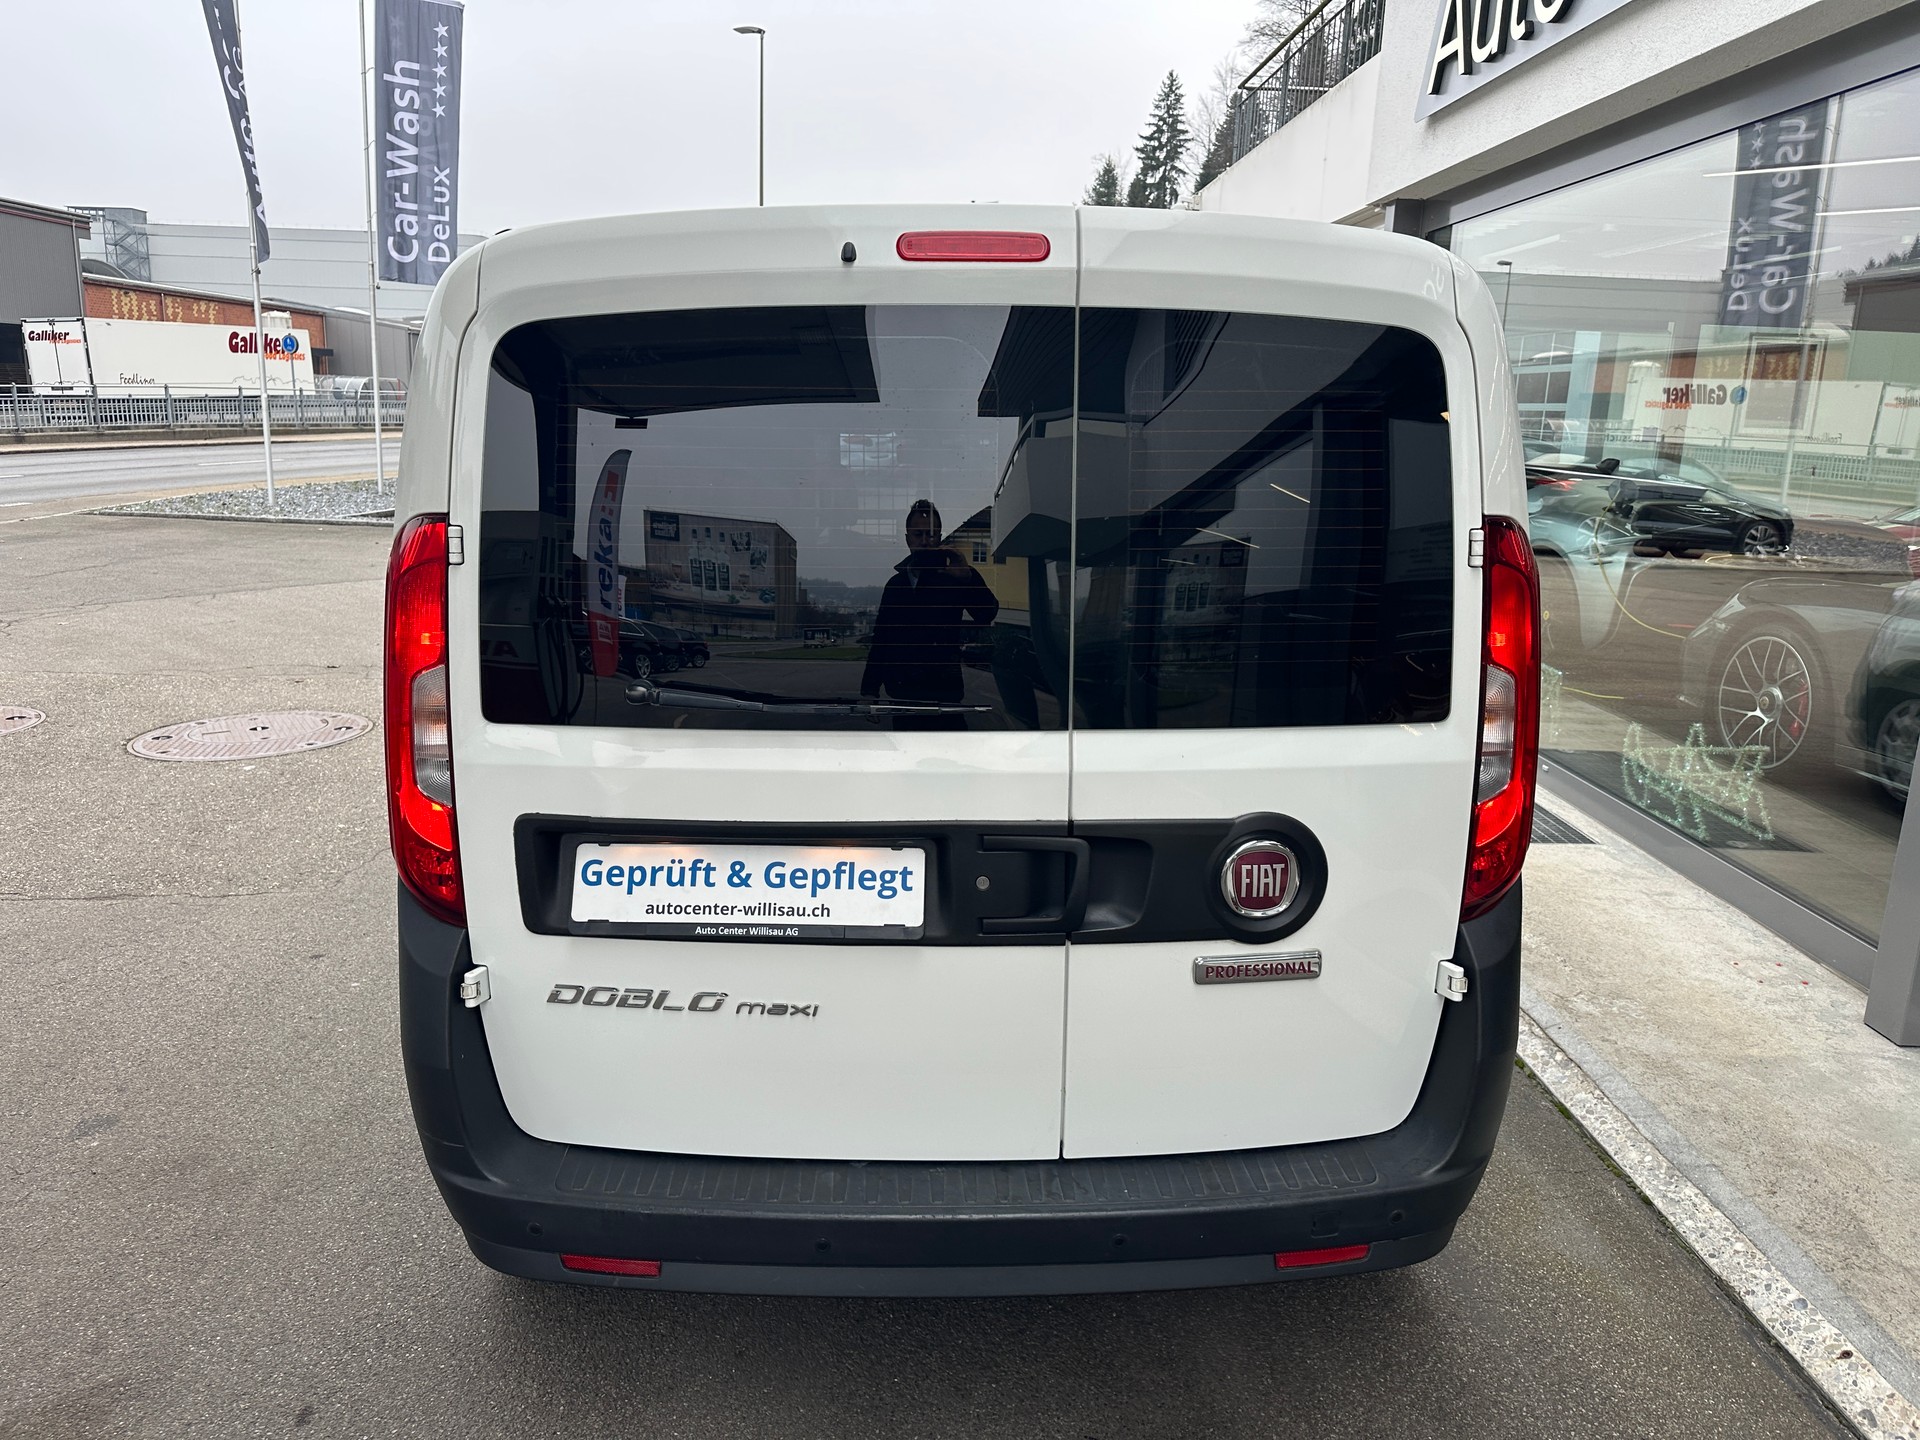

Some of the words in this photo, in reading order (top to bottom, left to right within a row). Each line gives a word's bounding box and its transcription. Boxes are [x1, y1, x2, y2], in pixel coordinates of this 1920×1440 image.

[1427, 0, 1572, 95] Au
[383, 60, 420, 263] Car-Wash
[427, 165, 450, 263] DeLux
[28, 330, 70, 341] Galliker
[228, 331, 286, 355] Gallke
[263, 351, 277, 360] ood
[279, 351, 306, 362] Logstics
[580, 858, 717, 895] Geprüft
[726, 860, 753, 888] &
[763, 860, 914, 899] Gepflegt
[1240, 863, 1285, 898] FIAT
[645, 902, 831, 918] autocenter-willisau.ch
[695, 925, 717, 935] Auto
[719, 925, 747, 935] Center
[749, 926, 784, 936] Willisau
[785, 926, 799, 936] AG
[1205, 960, 1314, 979] PROFESSIONAL
[735, 1001, 819, 1017] maxi
